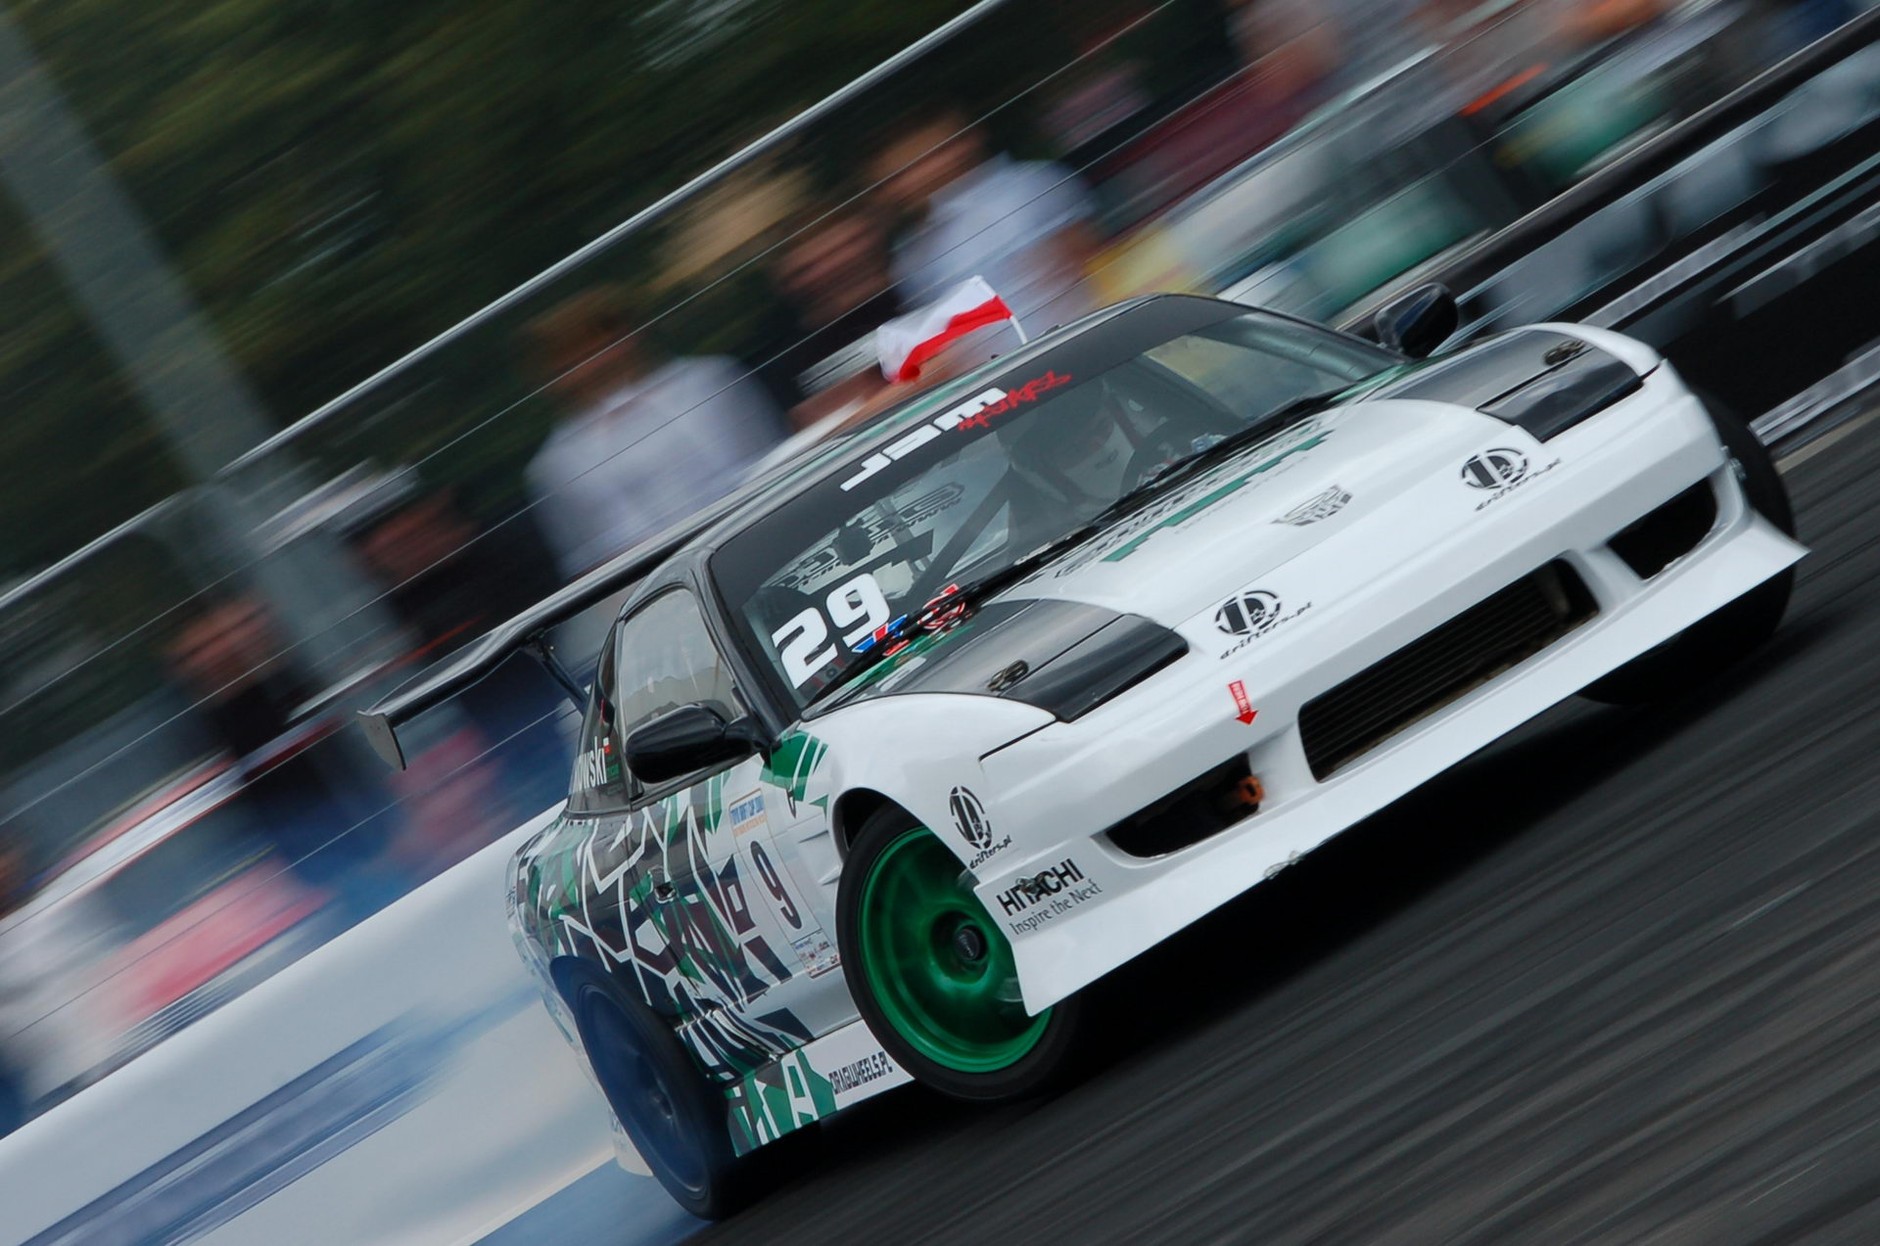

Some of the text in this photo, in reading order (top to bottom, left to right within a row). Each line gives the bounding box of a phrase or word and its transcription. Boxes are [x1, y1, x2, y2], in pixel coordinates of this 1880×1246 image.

[771, 573, 890, 690] 29
[750, 840, 802, 930] 9
[1009, 878, 1103, 936] Inspire the Next
